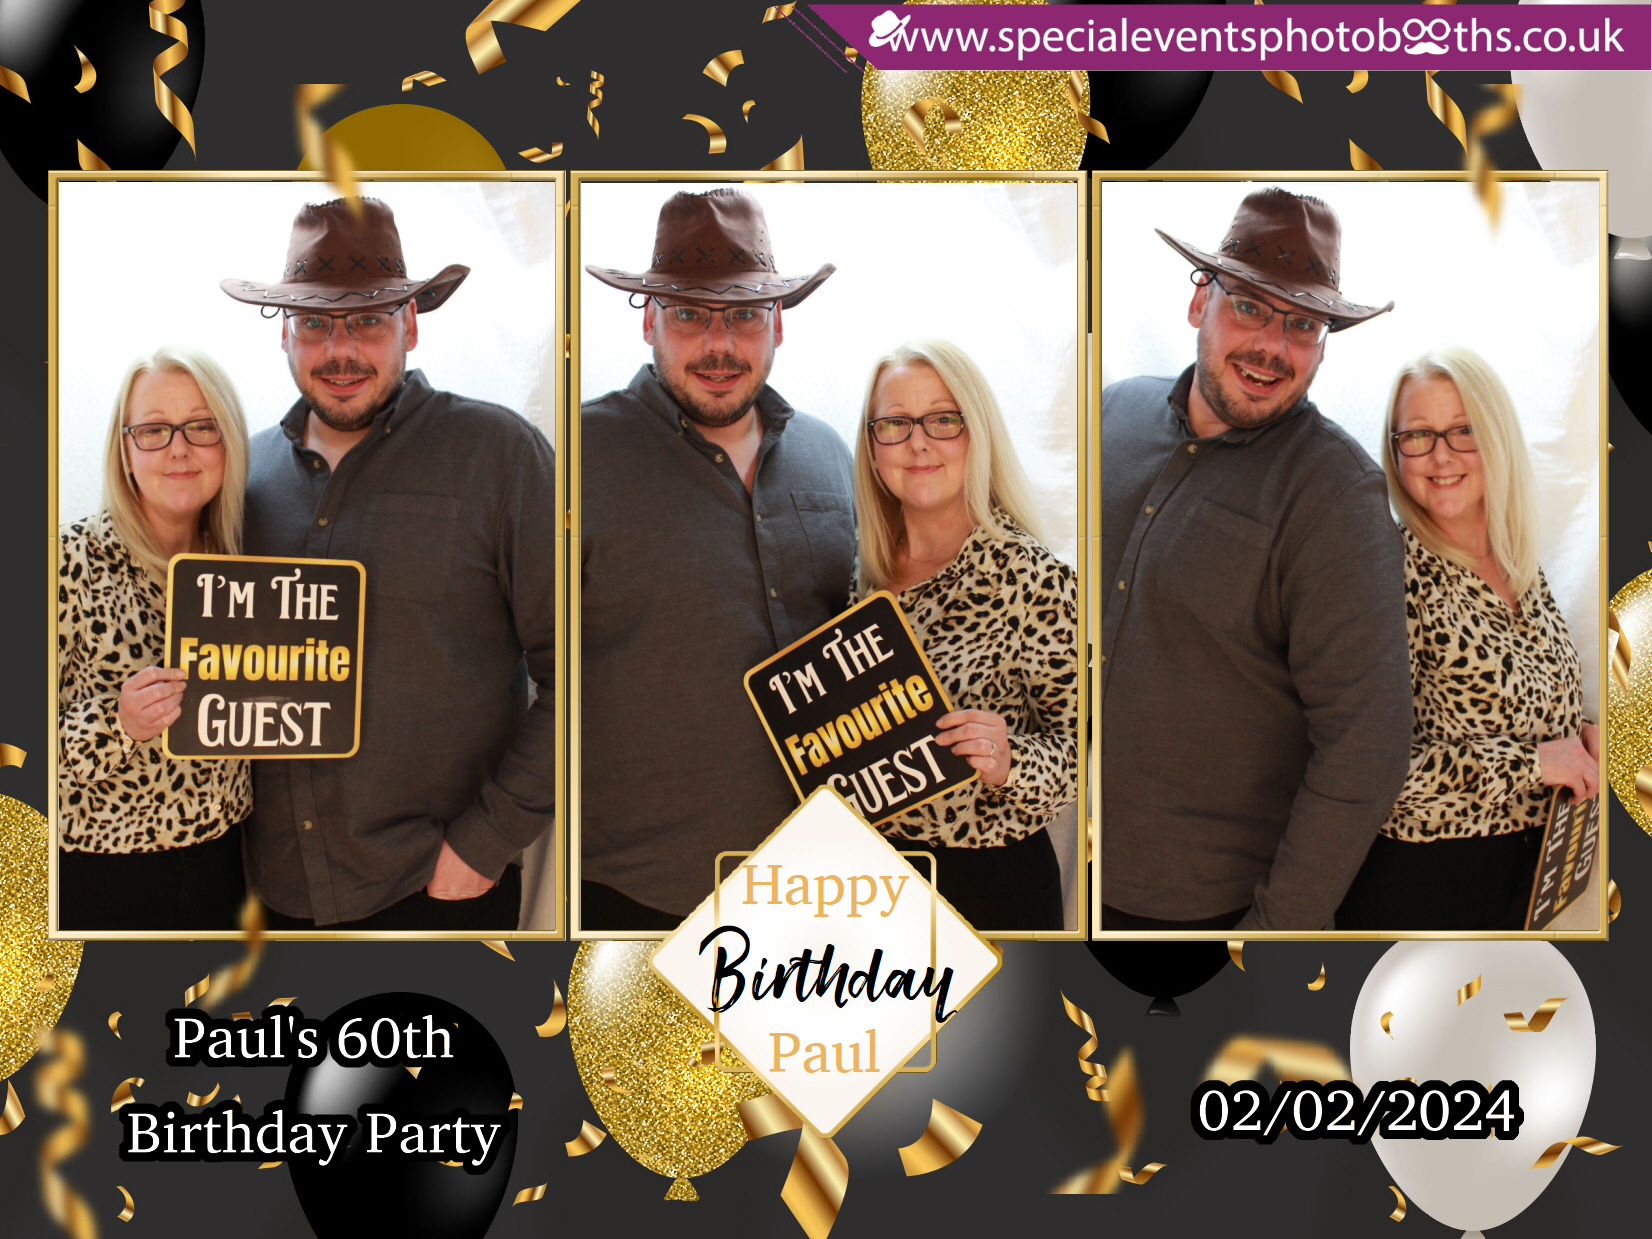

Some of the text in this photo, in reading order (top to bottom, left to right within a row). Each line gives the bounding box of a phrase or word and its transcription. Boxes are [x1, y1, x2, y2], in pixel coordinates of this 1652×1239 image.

[196, 567, 340, 621] I'M THE
[179, 637, 351, 682] Favourite
[768, 623, 895, 715] I'M THE
[197, 693, 332, 747] GUEST
[784, 674, 935, 776] Favourite
[1533, 803, 1571, 922] I'M THE
[1574, 795, 1600, 882] GUES
